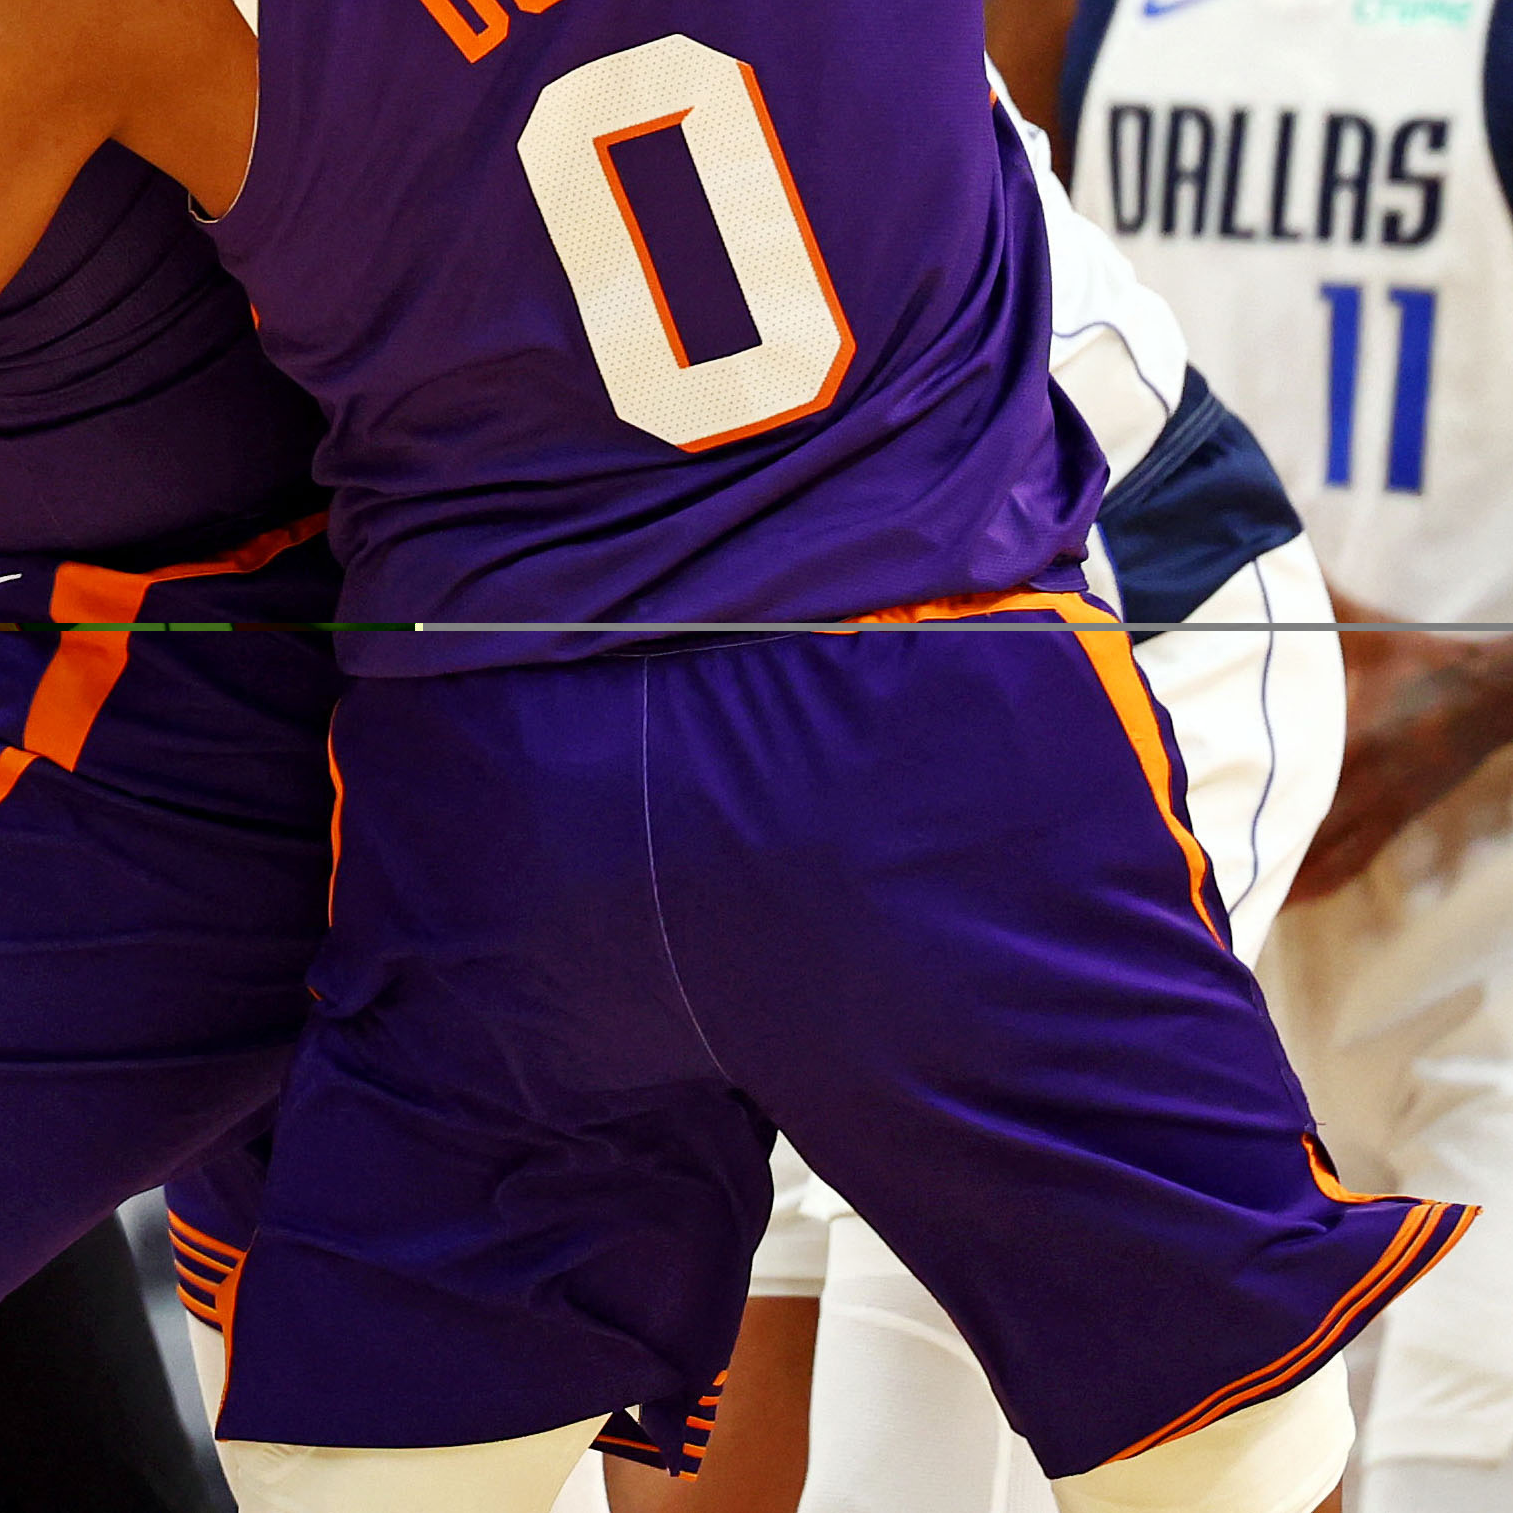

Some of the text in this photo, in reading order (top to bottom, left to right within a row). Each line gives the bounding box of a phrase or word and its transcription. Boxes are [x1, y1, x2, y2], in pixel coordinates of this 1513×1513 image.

[516, 33, 857, 454] 0
[1109, 103, 1450, 250] DALLAS
[1319, 282, 1439, 495] 11
